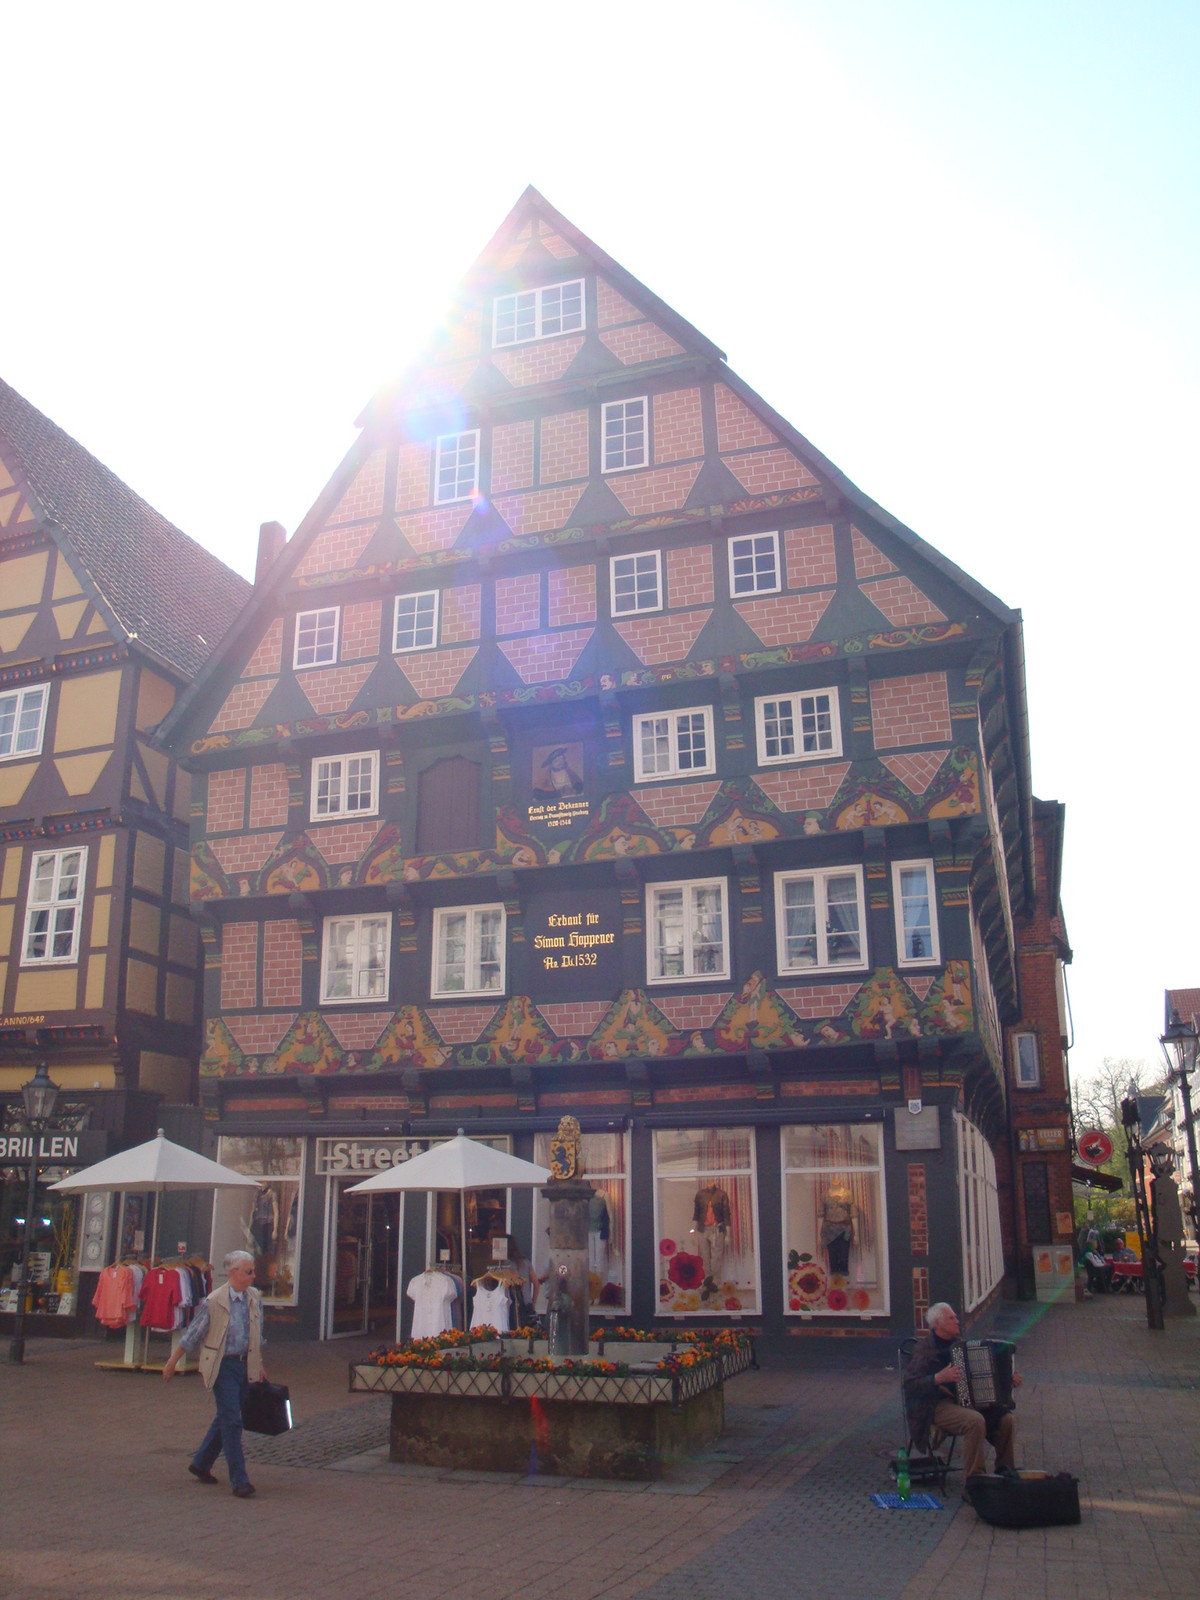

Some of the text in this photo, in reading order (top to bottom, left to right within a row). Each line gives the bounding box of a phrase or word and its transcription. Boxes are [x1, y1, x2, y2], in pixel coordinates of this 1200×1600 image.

[548, 911, 600, 928] Erbaut für
[533, 931, 615, 949] Simon Hoppener
[575, 952, 598, 967] 1532
